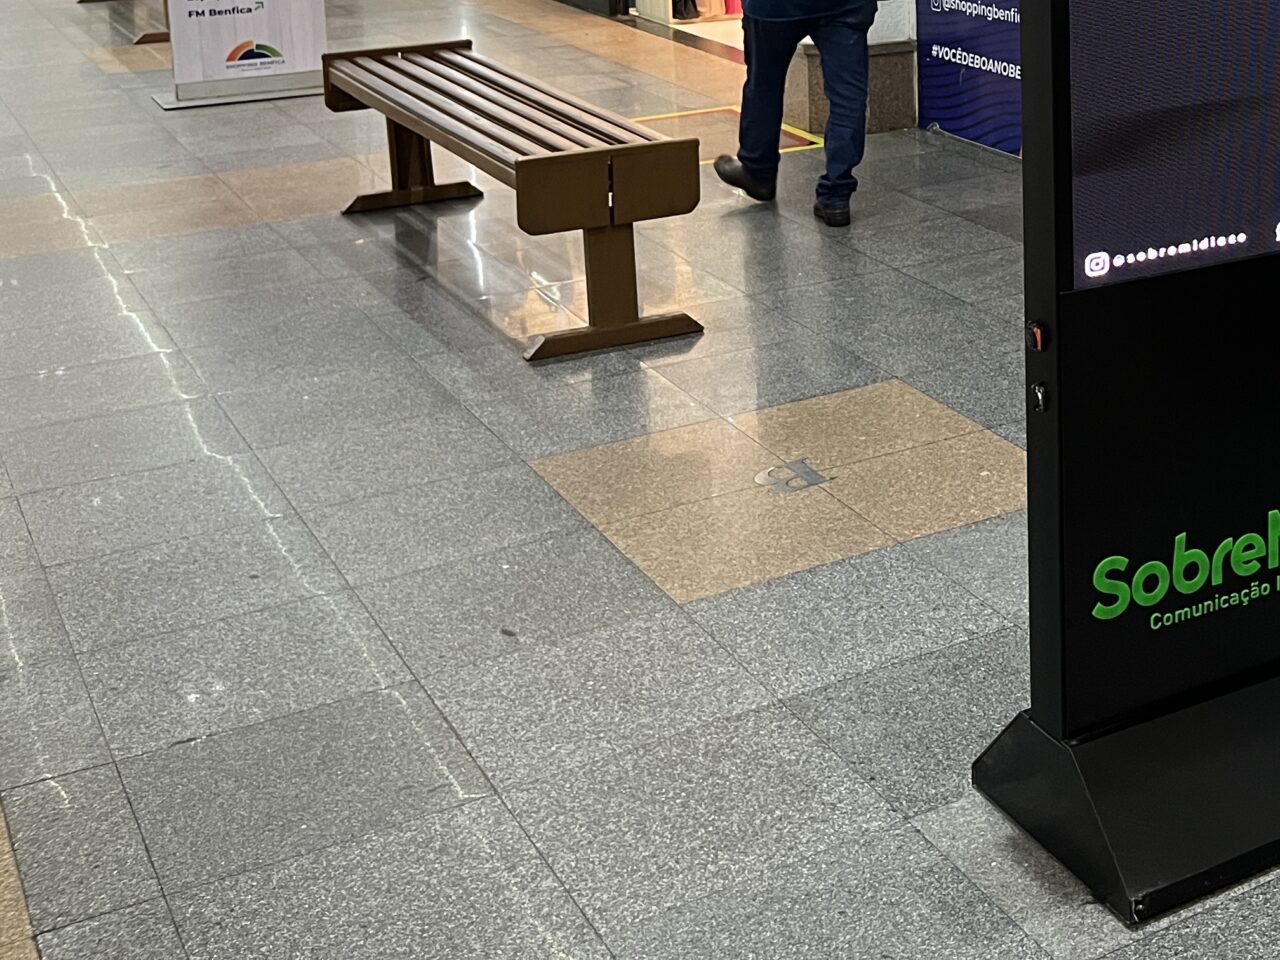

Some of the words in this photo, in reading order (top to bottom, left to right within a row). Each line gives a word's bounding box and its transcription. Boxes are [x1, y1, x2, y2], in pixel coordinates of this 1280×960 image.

[188, 10, 205, 18] FM
[209, 7, 252, 16] Benfica
[1150, 582, 1270, 630] Comunicação
